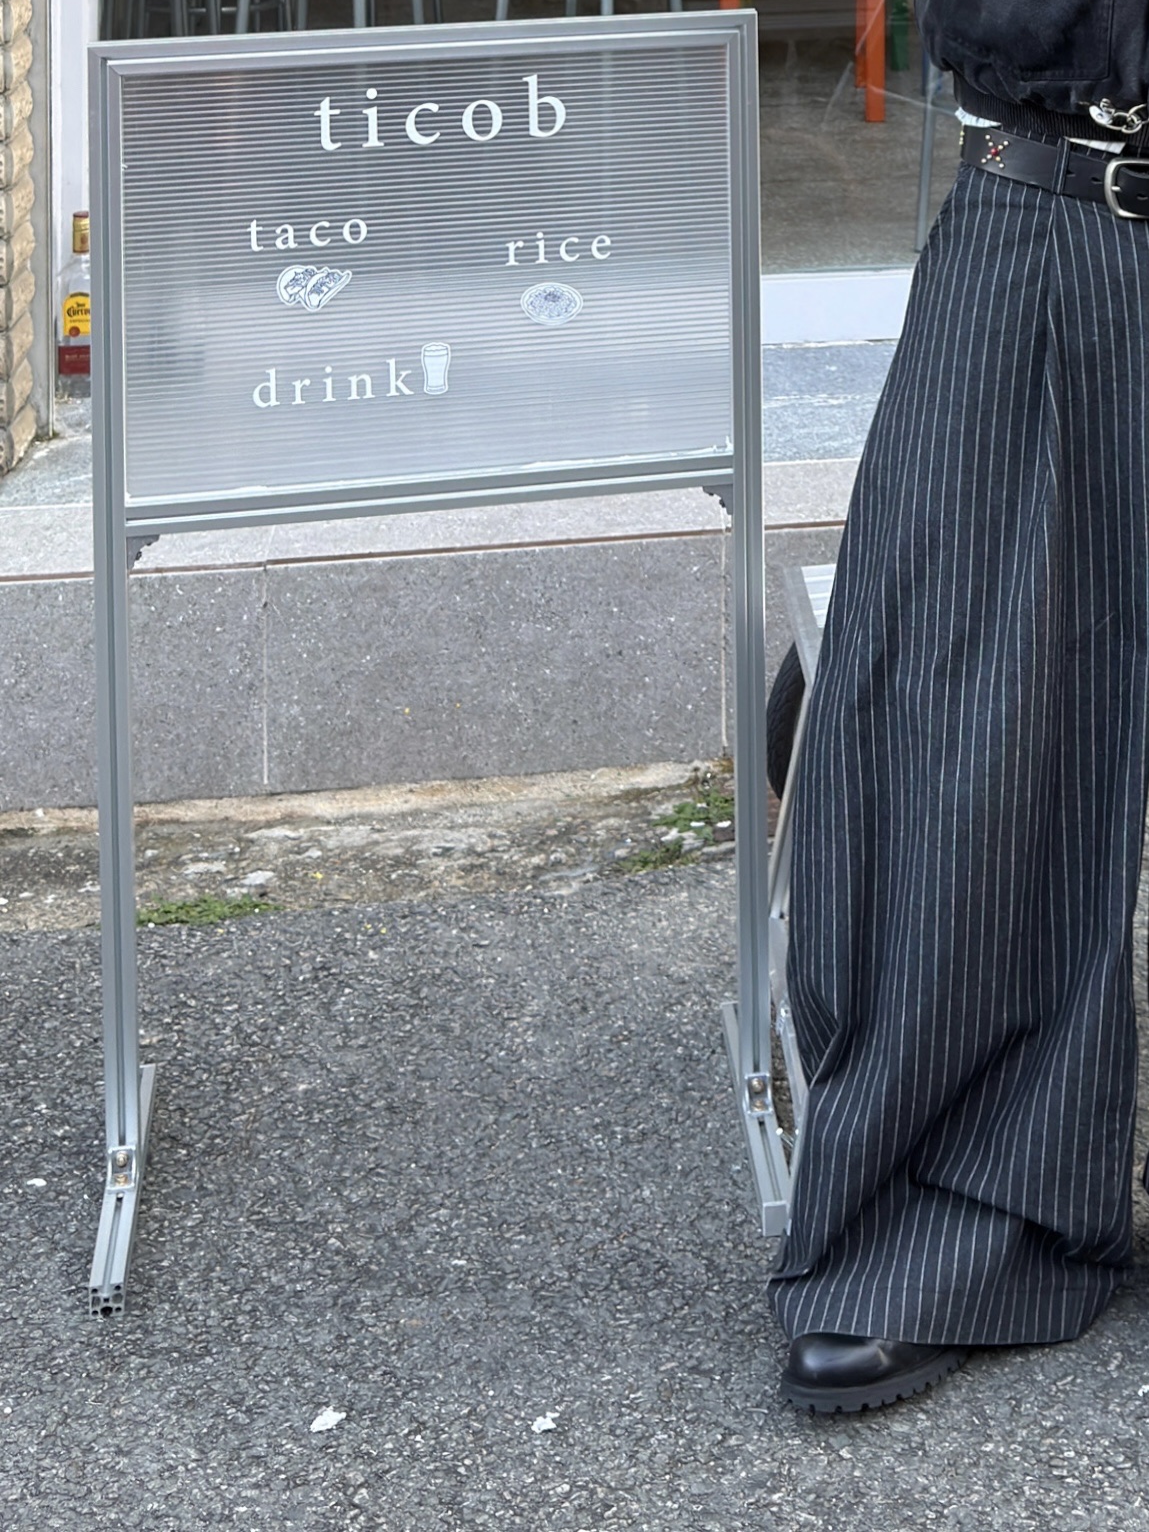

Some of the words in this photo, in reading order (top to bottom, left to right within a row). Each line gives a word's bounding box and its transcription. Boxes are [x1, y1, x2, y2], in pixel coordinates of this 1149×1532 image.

[314, 73, 567, 151] ticob
[247, 218, 368, 252] taco
[505, 231, 612, 266] rice
[67, 305, 90, 318] Cuerv
[252, 357, 414, 408] drink
